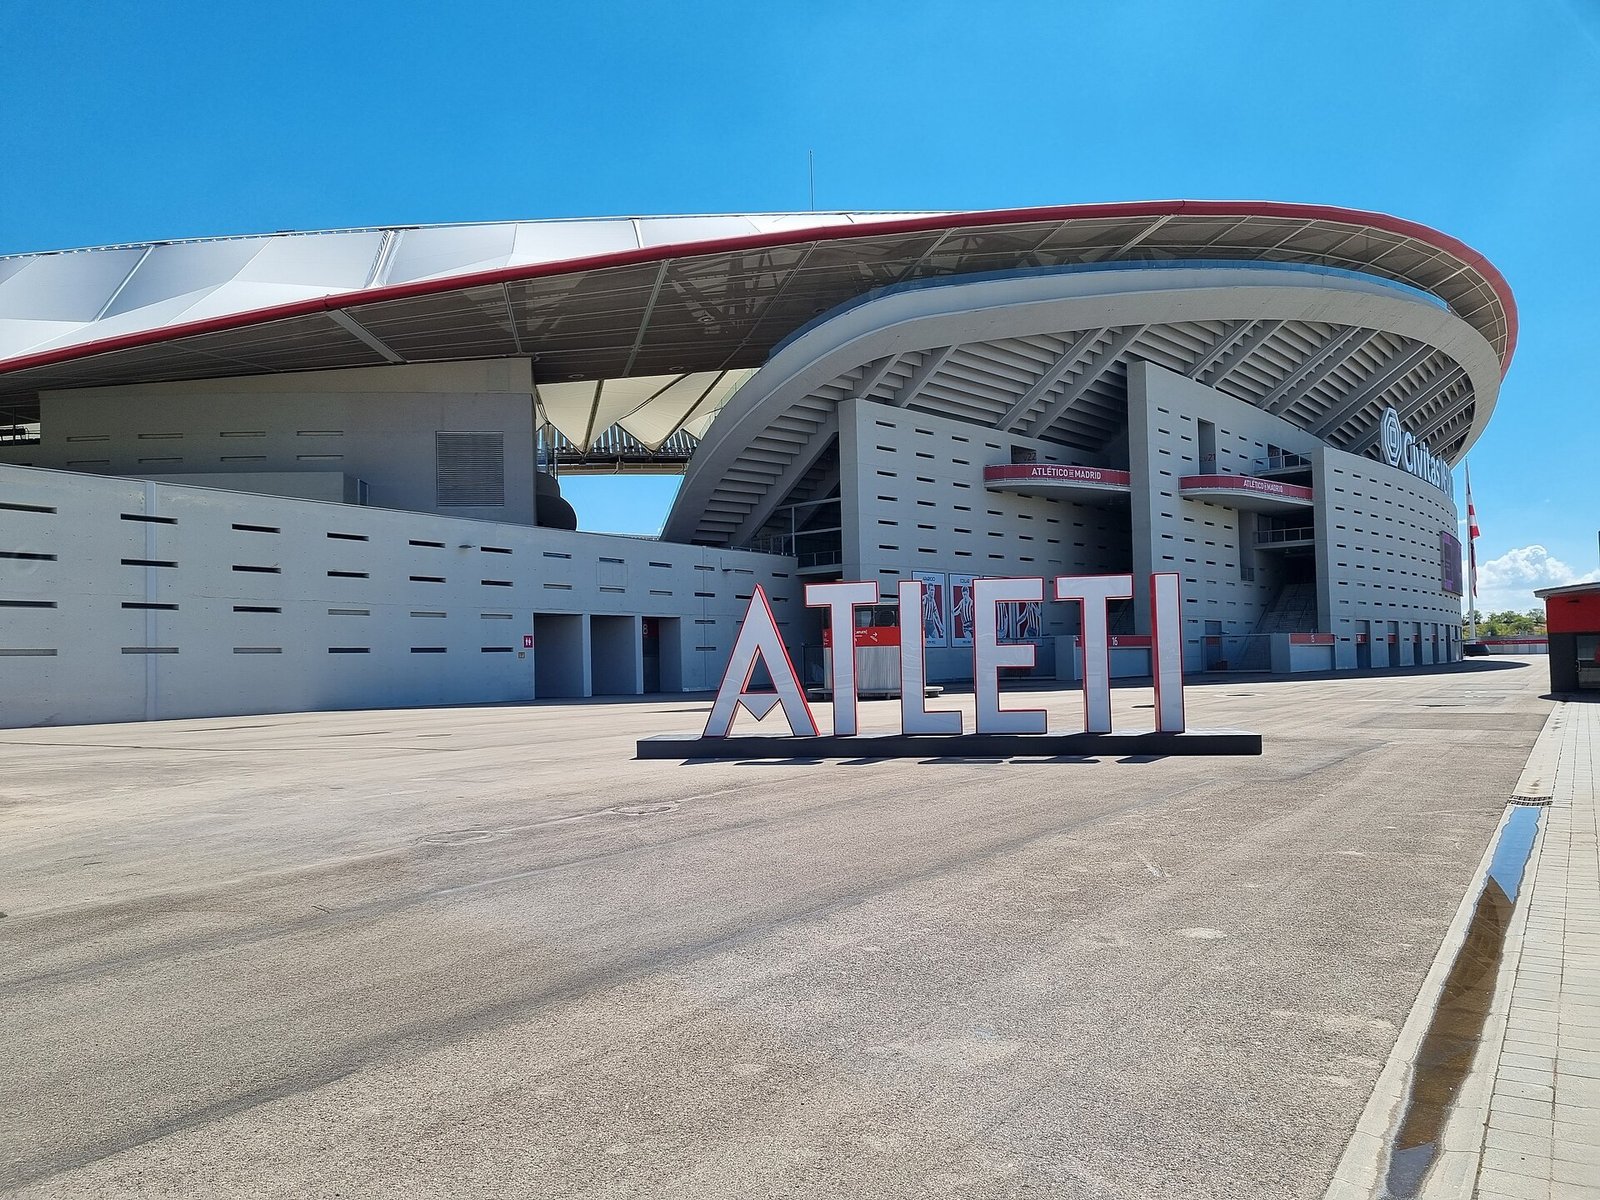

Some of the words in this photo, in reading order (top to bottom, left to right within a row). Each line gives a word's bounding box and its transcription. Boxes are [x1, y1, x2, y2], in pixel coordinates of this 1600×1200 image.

[1031, 466, 1068, 477] ATLÉTICO
[1074, 470, 1101, 479] MADRID
[1403, 431, 1440, 488] Civitas
[701, 571, 1185, 737] ATLETI
[1111, 636, 1119, 646] 16
